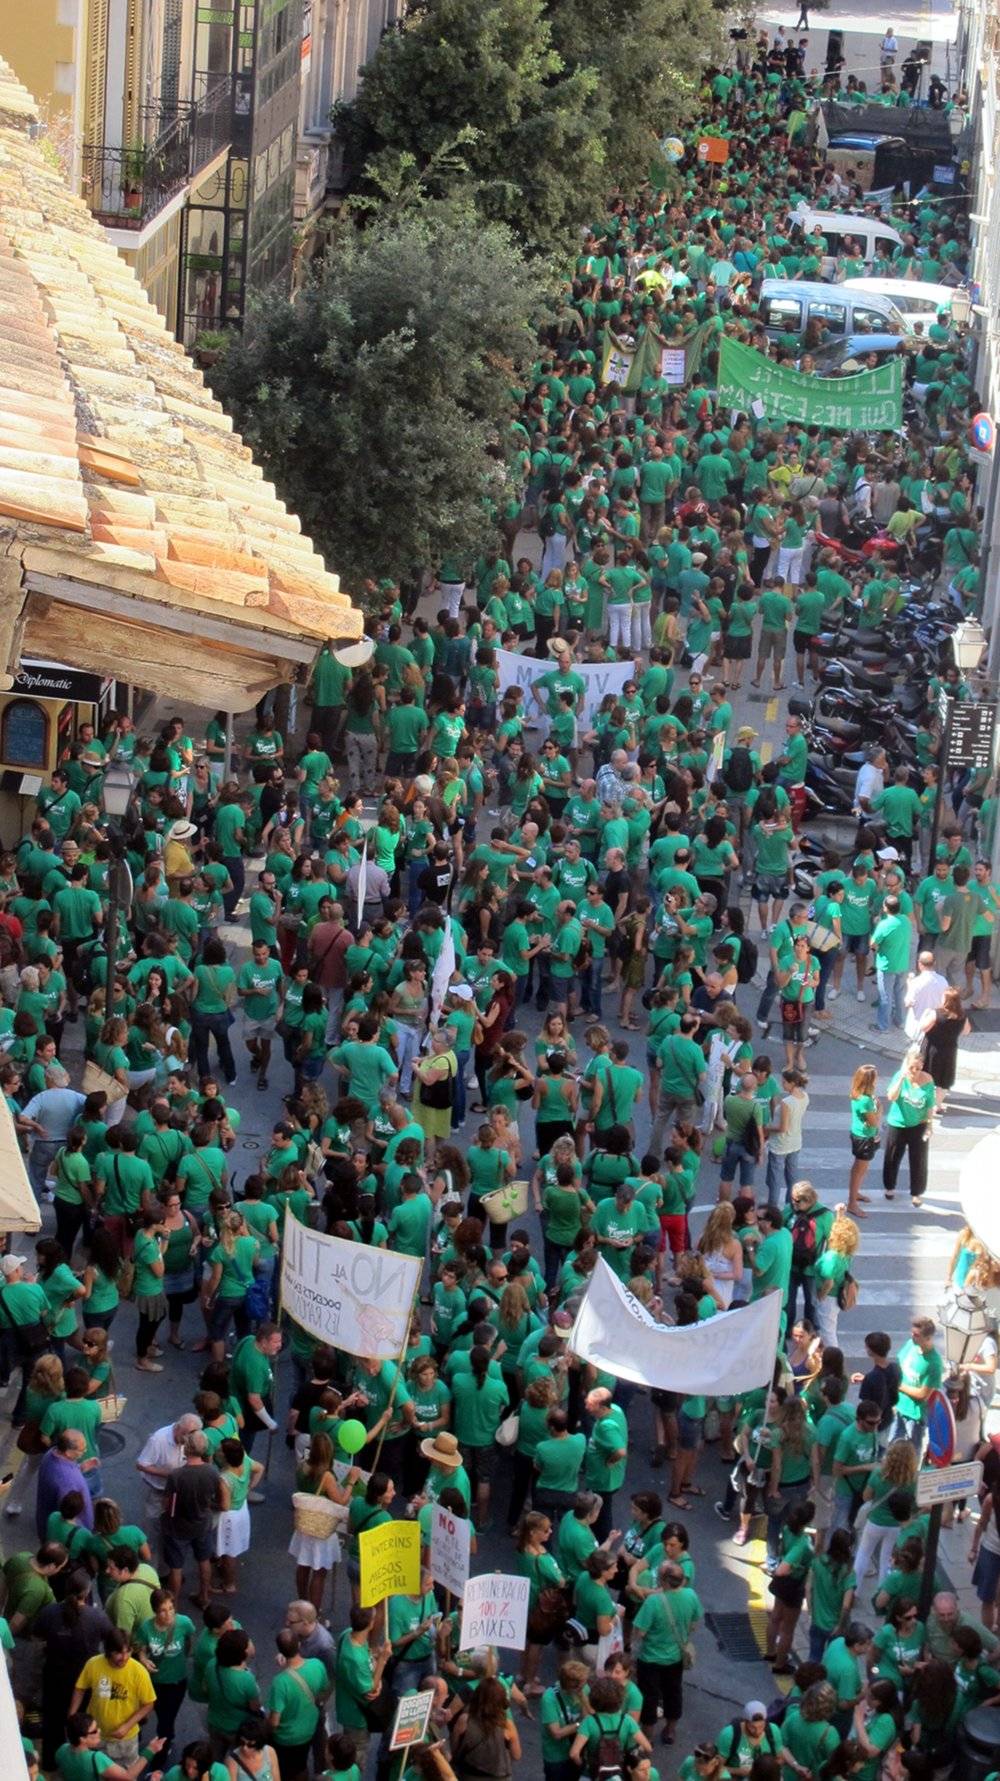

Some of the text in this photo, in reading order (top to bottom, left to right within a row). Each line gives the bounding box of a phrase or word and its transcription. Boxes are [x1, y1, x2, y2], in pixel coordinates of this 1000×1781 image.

[15, 672, 72, 690] Diplomatic
[438, 1513, 456, 1535] NO
[469, 1619, 516, 1640] BAIXES
